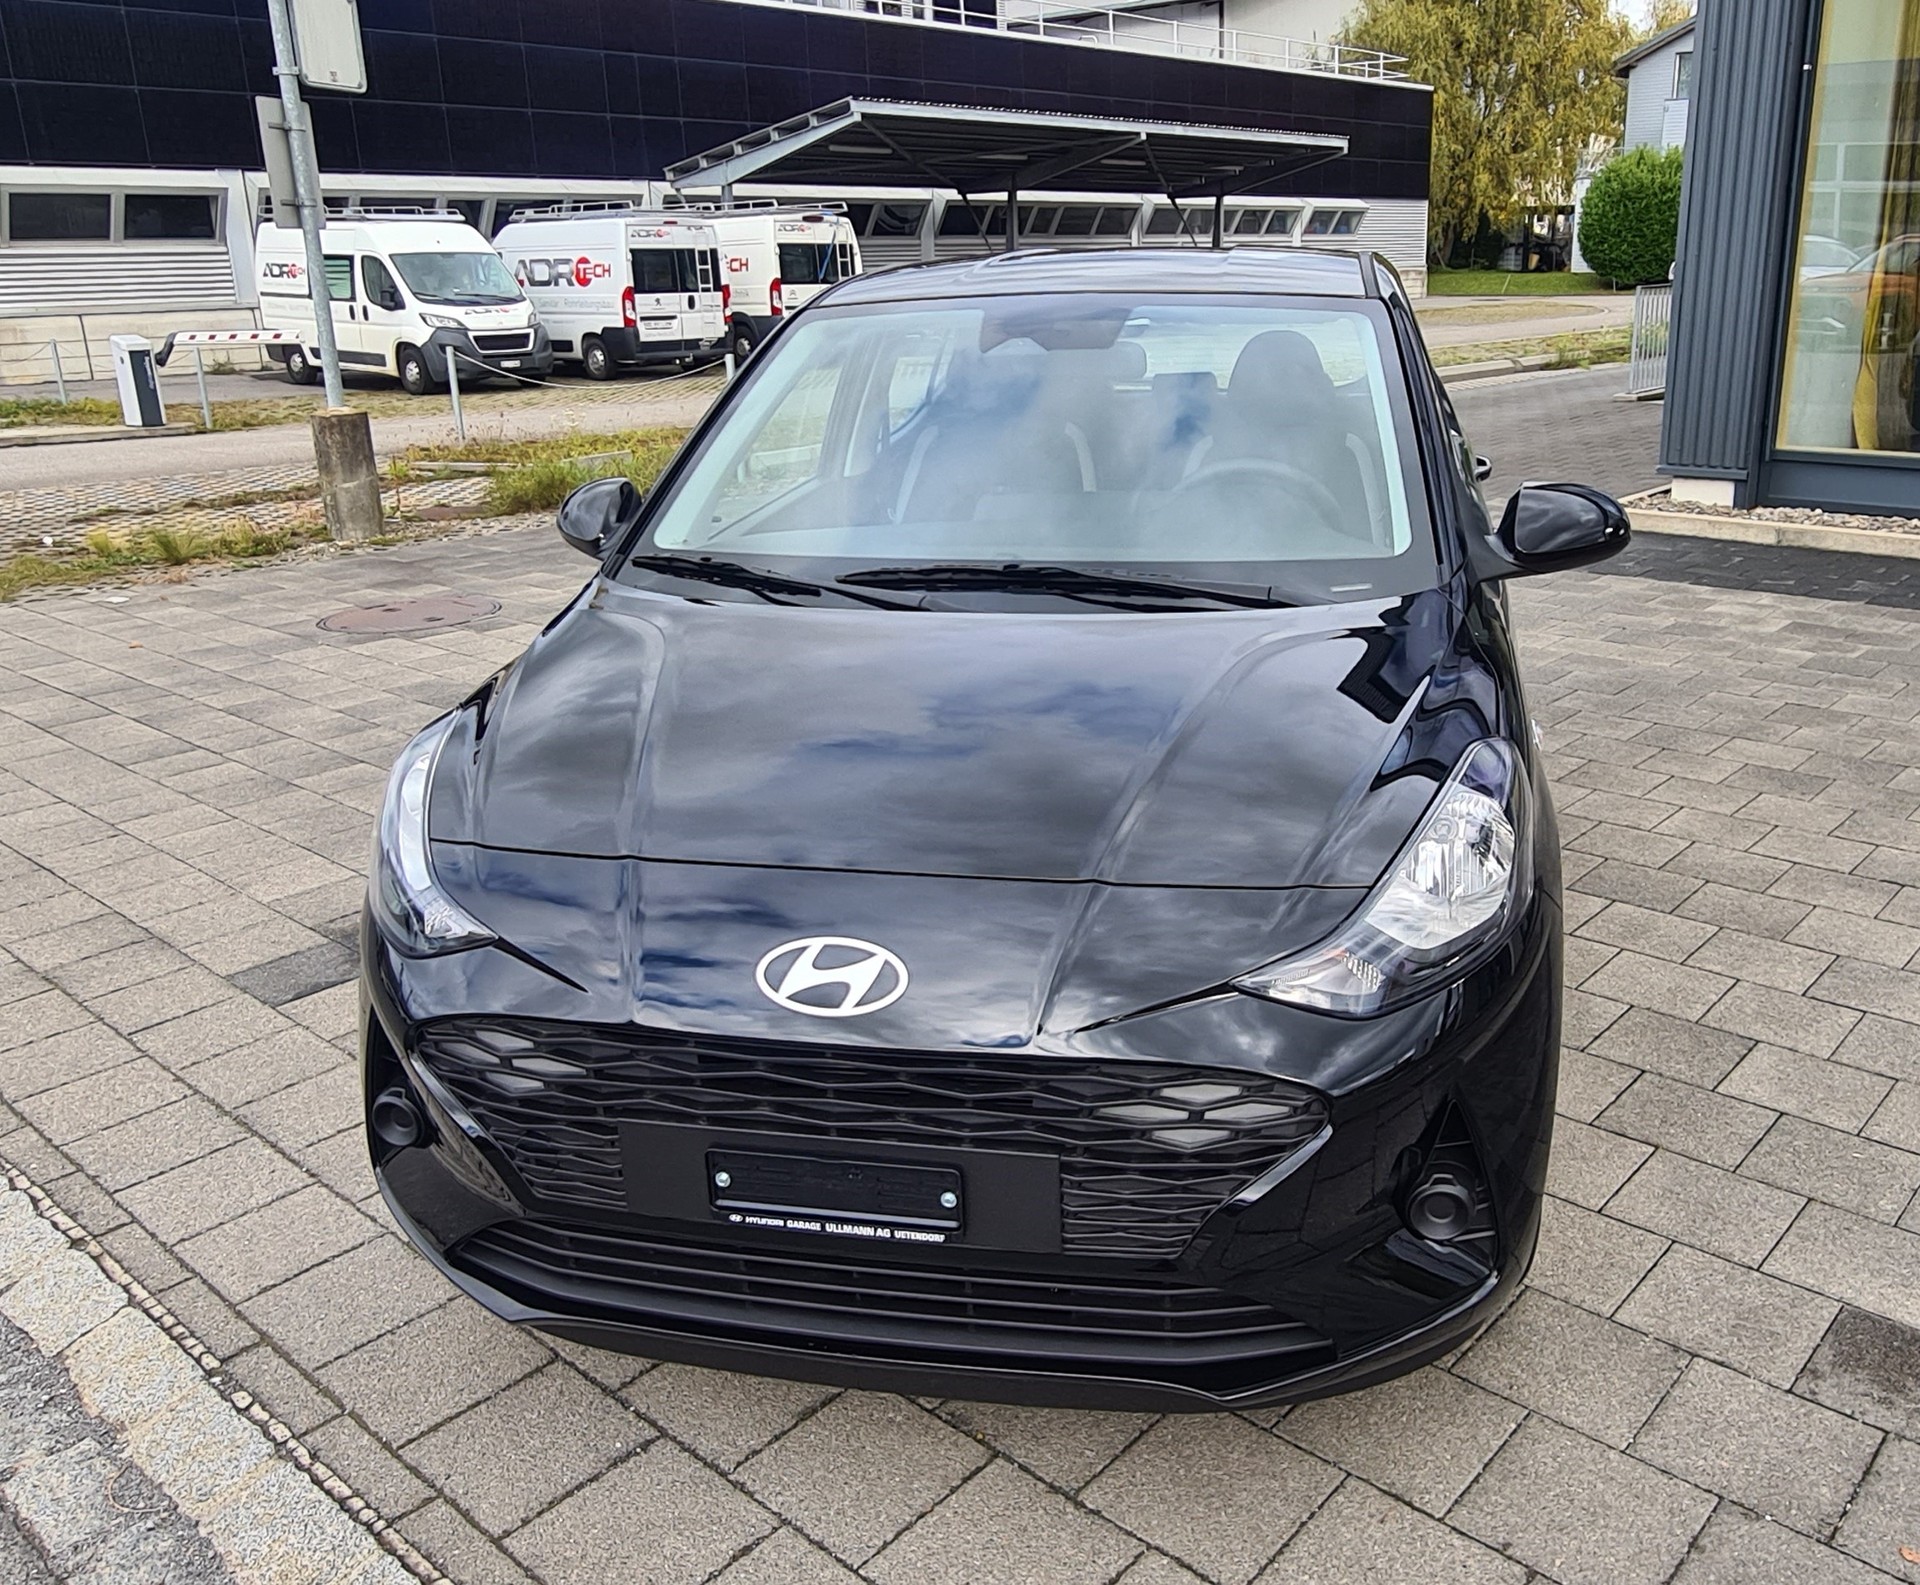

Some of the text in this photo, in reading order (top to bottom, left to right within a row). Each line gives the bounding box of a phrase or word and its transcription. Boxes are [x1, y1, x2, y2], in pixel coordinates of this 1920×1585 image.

[726, 257, 749, 272] CH
[786, 1219, 821, 1231] GARAGE
[825, 1222, 875, 1236] ULLMANN
[875, 1228, 891, 1238] AG
